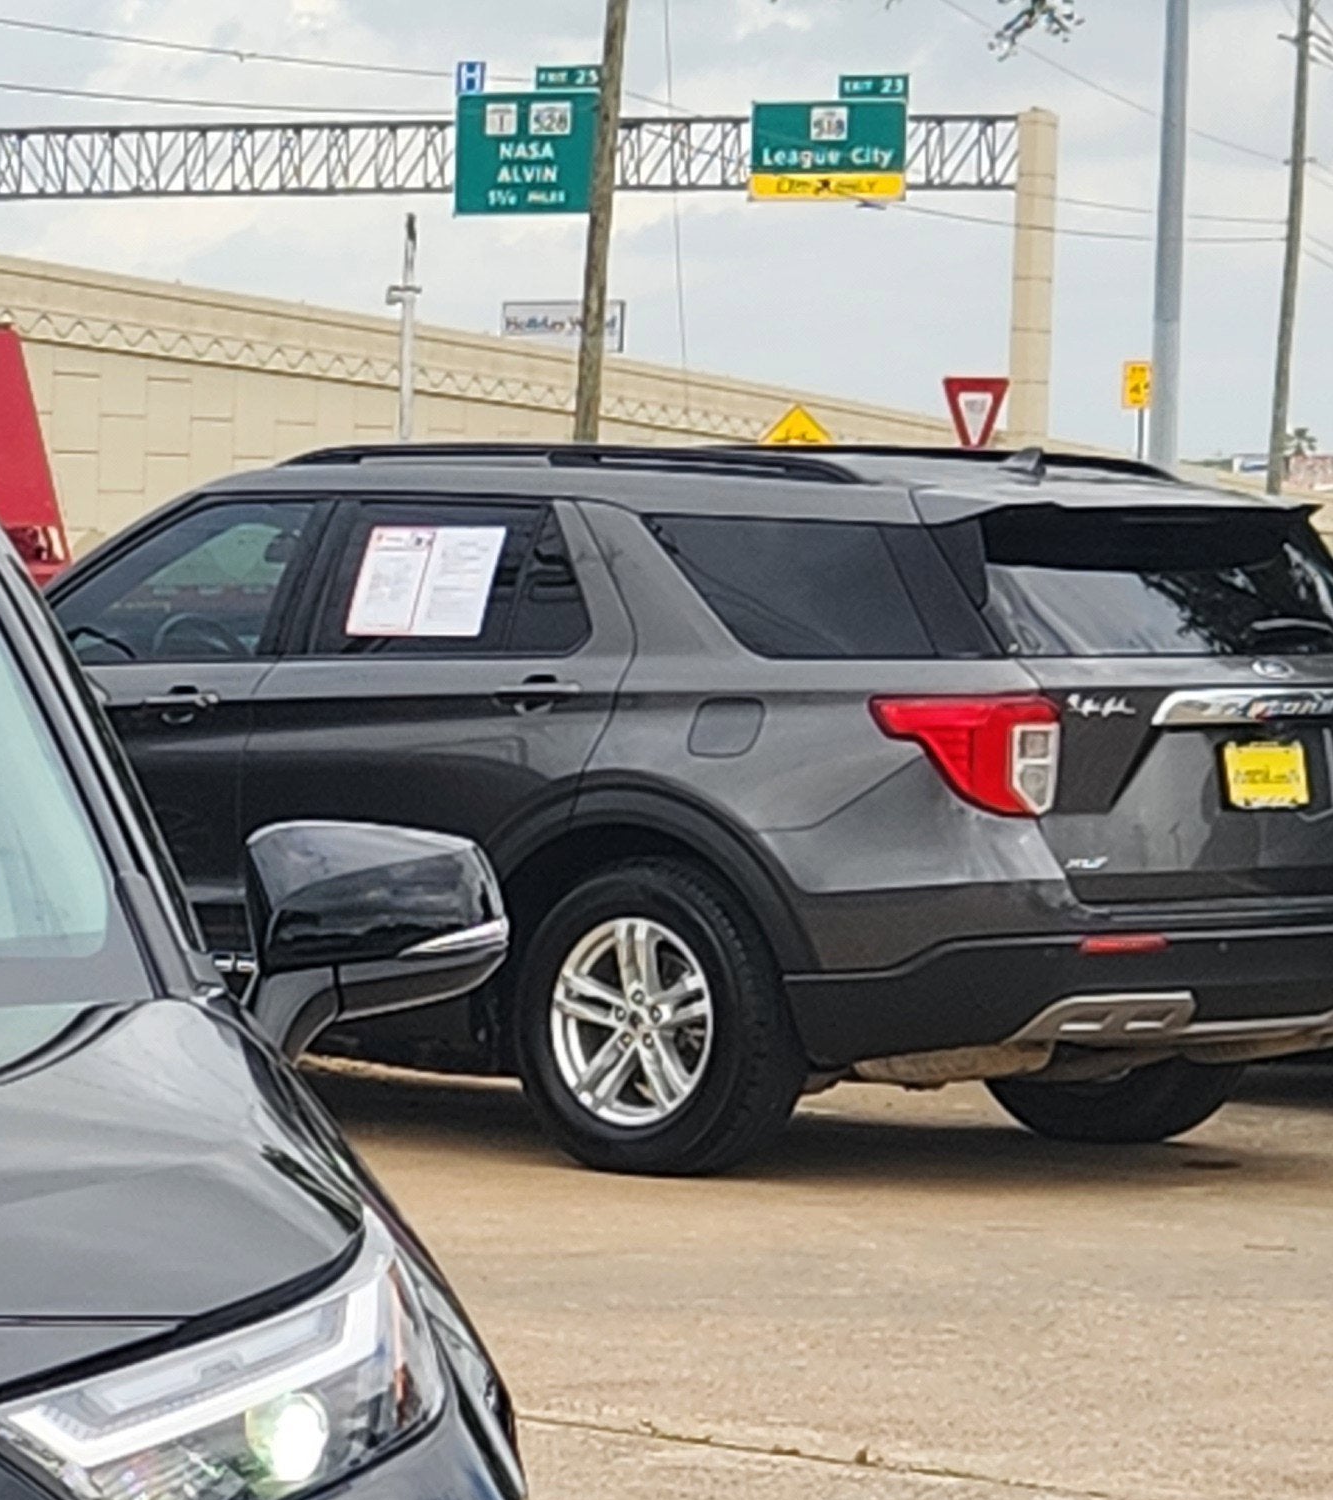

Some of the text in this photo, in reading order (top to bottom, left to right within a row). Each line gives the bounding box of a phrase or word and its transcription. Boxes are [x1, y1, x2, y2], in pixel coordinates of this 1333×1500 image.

[843, 78, 904, 94] EXIT 23
[499, 141, 555, 160] NASA
[762, 146, 895, 169] League City
[497, 165, 558, 183] ALVIN
